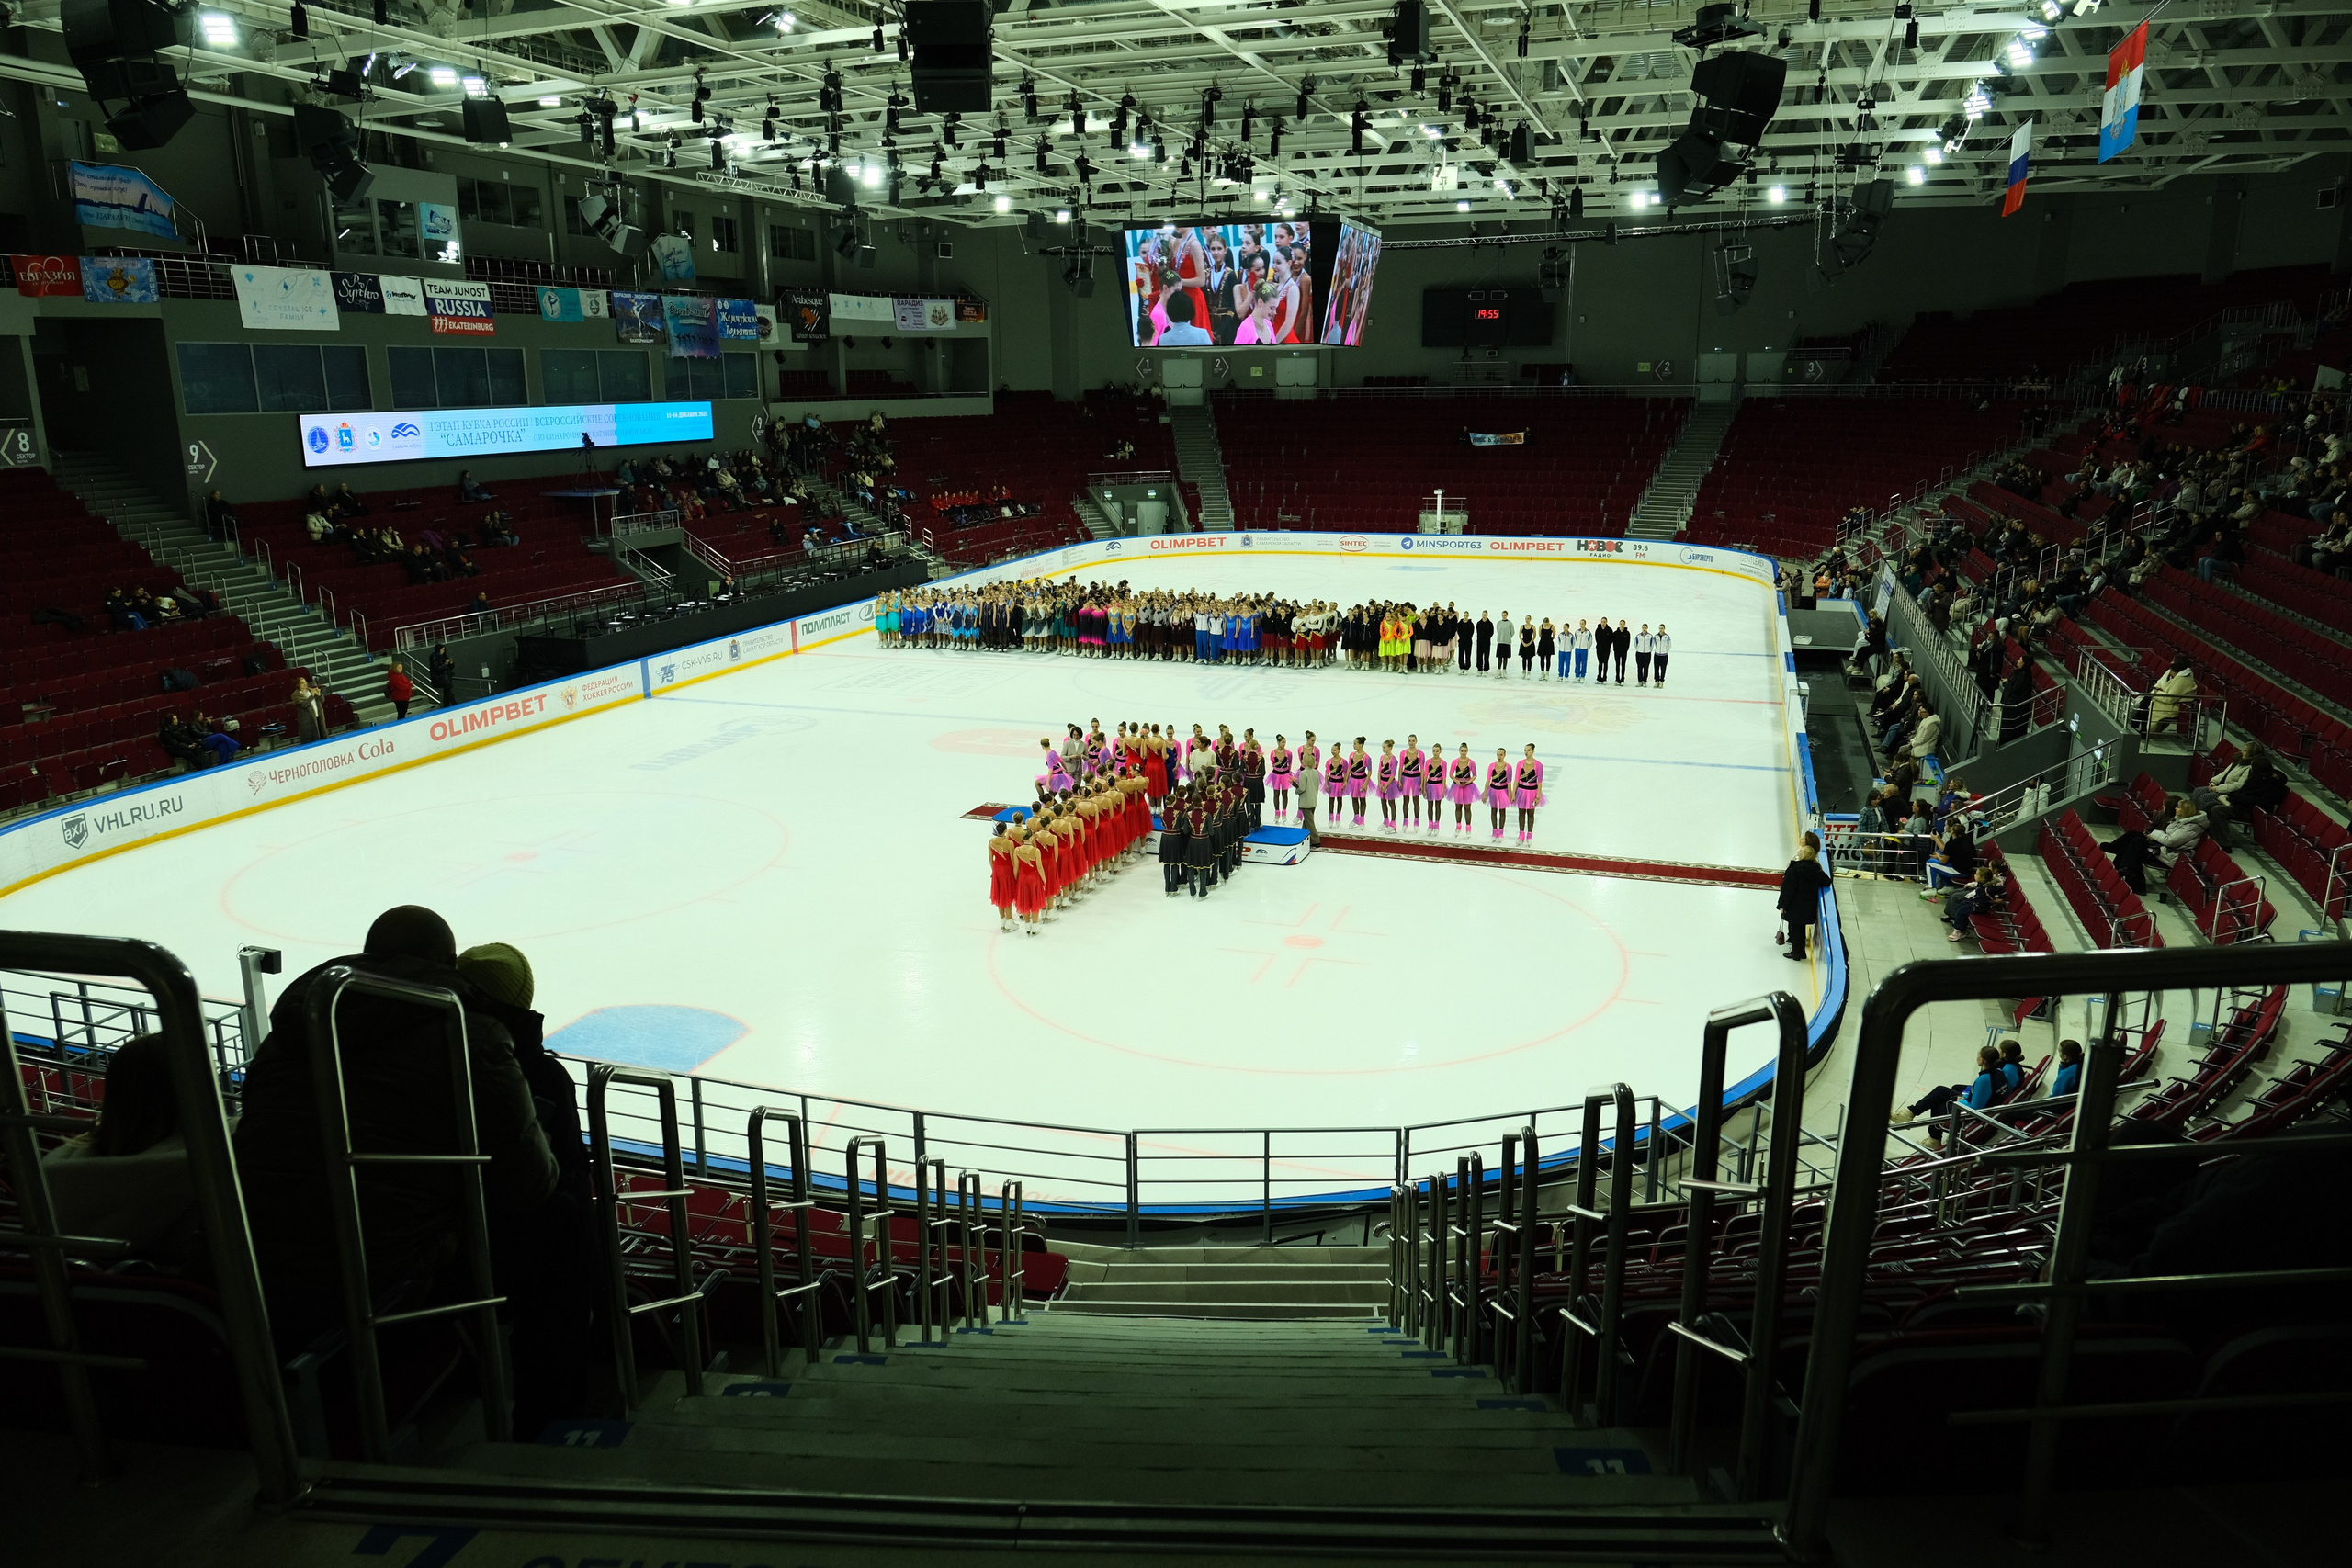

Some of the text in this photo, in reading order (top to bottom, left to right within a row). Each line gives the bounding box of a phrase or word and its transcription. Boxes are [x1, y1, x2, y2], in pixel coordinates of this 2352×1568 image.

[19, 271, 75, 281] ЕВРАЗИЯ
[338, 277, 379, 304] Synchro
[427, 284, 486, 298] TEAM JUNOST
[792, 294, 823, 307] Arabesque
[435, 299, 487, 318] RUSSIA
[1477, 309, 1499, 319] 19:55
[448, 321, 494, 332] EKATERINBURG
[1215, 359, 1221, 367] 2
[1665, 362, 1670, 371] 2
[1808, 362, 1814, 373] 3
[435, 419, 459, 431] ЭТАП
[461, 418, 492, 430] КУБКА
[492, 417, 529, 428] РОССИИ
[535, 412, 662, 427] ВСЕРОССИЙСКИЕ СОРЕВНОВАНИЯ
[17, 432, 29, 452] 8
[17, 452, 36, 460] СЕКТОР
[189, 445, 199, 463] 9
[1150, 536, 1227, 549] OLIMPBET
[1416, 540, 1482, 549] MINSPORT63
[1490, 542, 1565, 551] OLIMPBET
[801, 612, 851, 636] ПОЛИПЛАСТ
[682, 650, 723, 671] CSK-VVS.RU
[662, 663, 676, 685] 75
[581, 676, 619, 693] ФЕДЕРАЦИЯ
[582, 682, 634, 702] ХОККЕЯ РОССИИ
[430, 694, 548, 741] OLIMPBET
[268, 739, 395, 784] ЧЕРНОГОЛОВКА Cola
[94, 795, 184, 834] VHLRU.RU
[64, 820, 86, 842] ВХЛ
